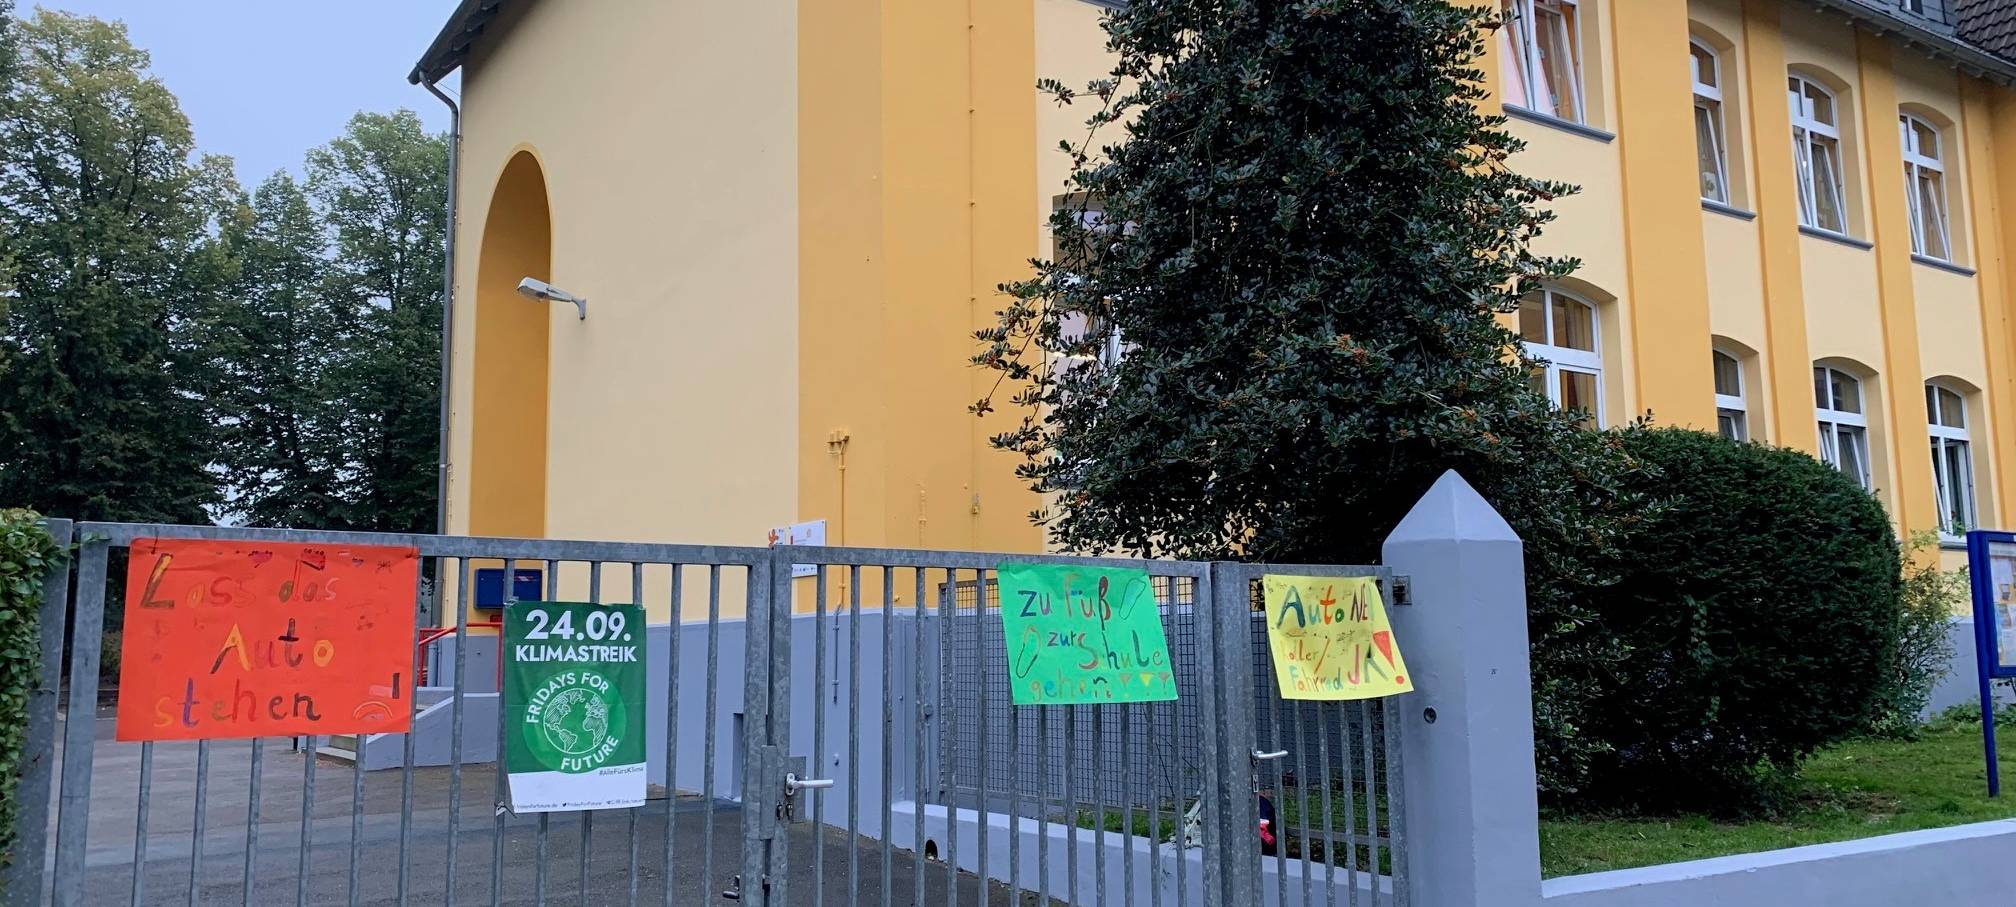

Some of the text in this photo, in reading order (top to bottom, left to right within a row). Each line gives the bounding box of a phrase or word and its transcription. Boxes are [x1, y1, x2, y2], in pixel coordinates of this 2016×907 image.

[139, 553, 340, 609] Lass das
[523, 609, 632, 642] 24.09.
[1276, 585, 1345, 629] Auto
[210, 618, 335, 674] Auto
[515, 644, 638, 663] KLIMASTREIK
[1047, 631, 1076, 648] zur
[153, 677, 322, 729] stehen
[526, 672, 609, 724] FRIDAYS FOR
[560, 734, 619, 772] FUTURE
